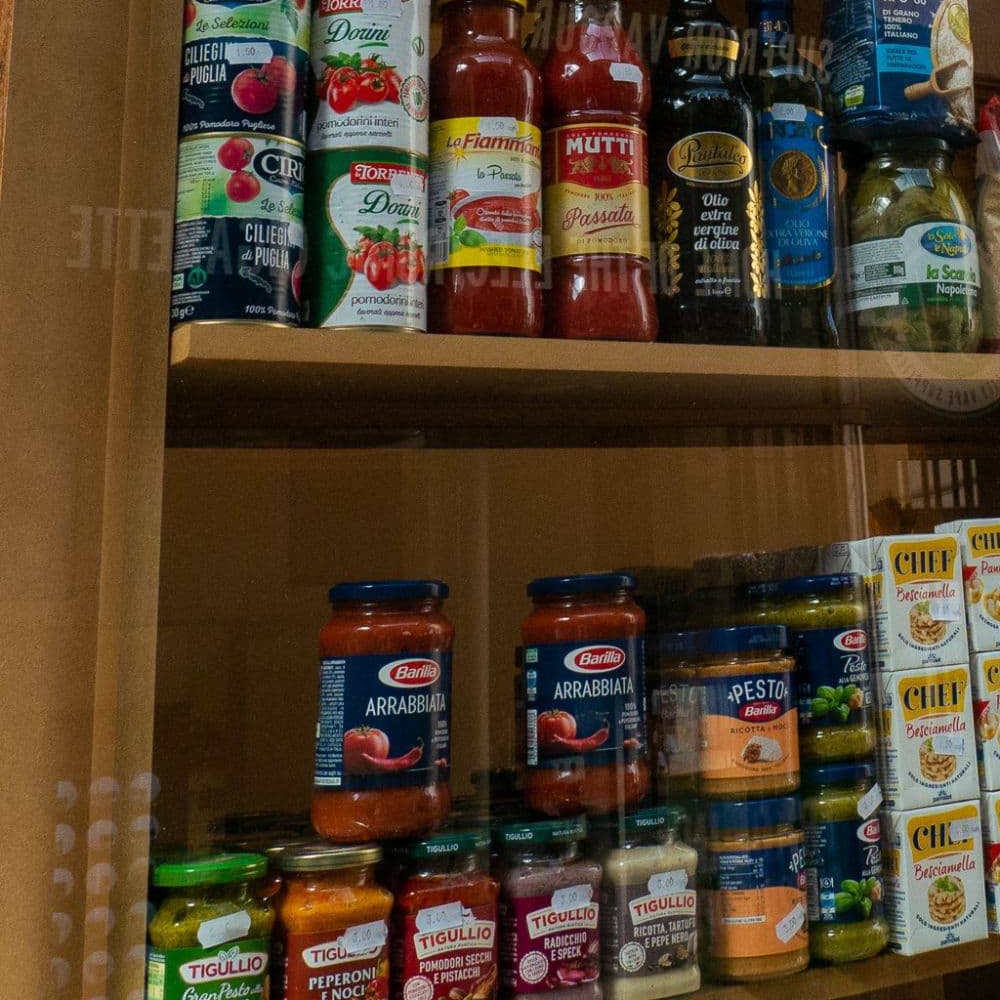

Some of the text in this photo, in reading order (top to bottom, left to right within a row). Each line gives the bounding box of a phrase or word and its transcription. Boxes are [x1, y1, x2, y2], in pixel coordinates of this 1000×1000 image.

[883, 17, 913, 25] TENERO
[892, 9, 920, 18] GRANO
[196, 16, 271, 33] Le Selezioni
[323, 18, 393, 45] Dorini
[884, 23, 902, 31] 100%
[884, 30, 919, 40] ITALIANO
[190, 63, 227, 85] PUGLIA
[317, 115, 400, 131] pomodorini interi
[447, 136, 462, 148] La
[566, 136, 635, 156] MUTTI
[487, 164, 523, 181] Passata
[358, 189, 421, 217] Dorini
[701, 192, 729, 207] Olio
[562, 203, 636, 231] Passata
[700, 209, 732, 222] extra
[785, 219, 810, 229] OLIO
[693, 224, 740, 240] vergine
[694, 238, 740, 251] di oliva
[242, 249, 290, 271] di PUGLIA
[926, 263, 939, 280] la
[245, 304, 266, 315] 100%
[894, 549, 955, 575] CHEF
[895, 583, 957, 602] Besciamella
[578, 650, 622, 666] Barilla
[393, 663, 438, 681] Barilla
[553, 675, 634, 700] ARRABBIATA
[731, 678, 786, 704] PESTO
[903, 680, 966, 712] CHEF
[365, 692, 447, 717] ARRABBIATA
[744, 704, 777, 717] Barilla
[729, 725, 766, 735] RICOTTA
[905, 717, 967, 738] Besciamella
[636, 816, 665, 827] TIGULLIO
[504, 831, 534, 841] TIGULLIO
[426, 843, 459, 854] TIGULLIO
[914, 856, 977, 880] Besciamella
[632, 896, 695, 917] TIGULLIO
[531, 907, 597, 930] TIGULLIO
[418, 927, 492, 950] TIGULLIO
[633, 922, 668, 939] RICOTTA,
[543, 932, 588, 951] RADICCHIO
[650, 931, 690, 948] PEPE NERO
[419, 950, 493, 973] POMODORI SECCHI
[557, 946, 582, 961] SPECK
[188, 955, 263, 980] TIGULLIO
[440, 965, 481, 983] PISTACCHI
[308, 967, 378, 990] PEPERONI
[330, 986, 366, 1000] NOCI
